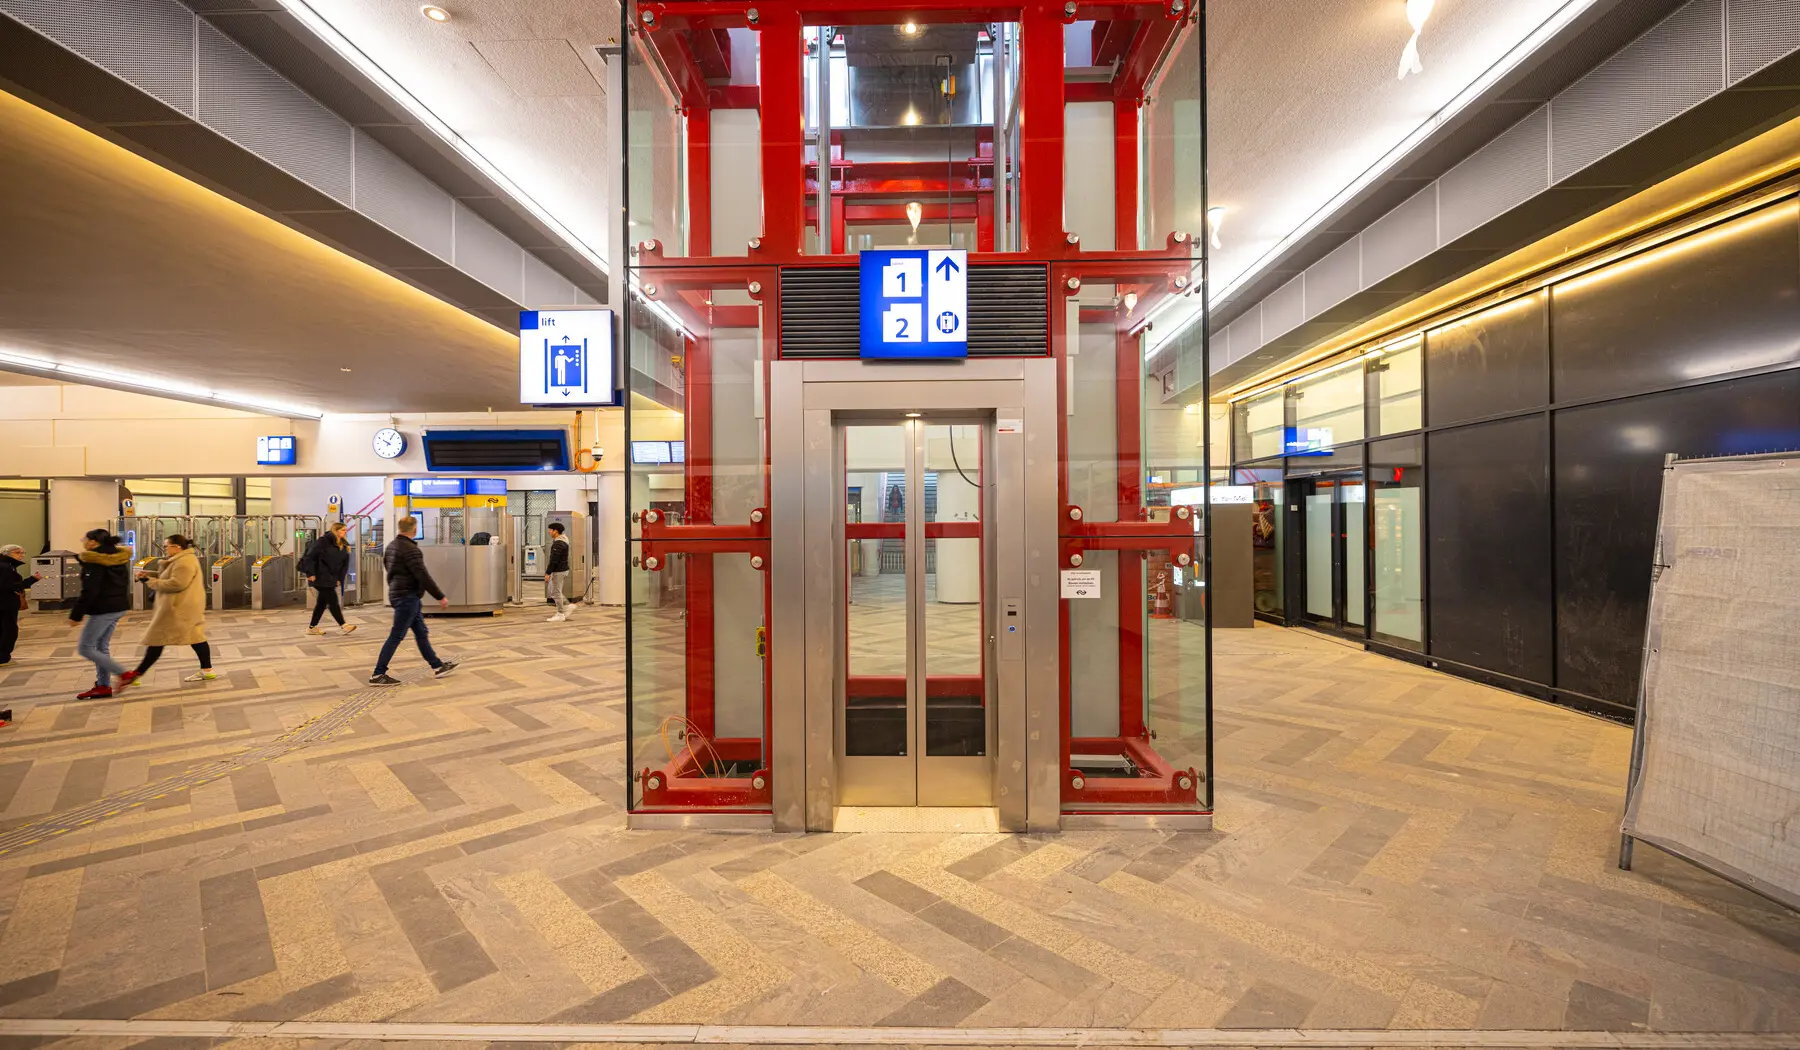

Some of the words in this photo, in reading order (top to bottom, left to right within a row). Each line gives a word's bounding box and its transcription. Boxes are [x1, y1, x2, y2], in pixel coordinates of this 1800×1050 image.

[896, 272, 906, 293] 1
[541, 317, 556, 327] lift
[895, 317, 909, 338] 2
